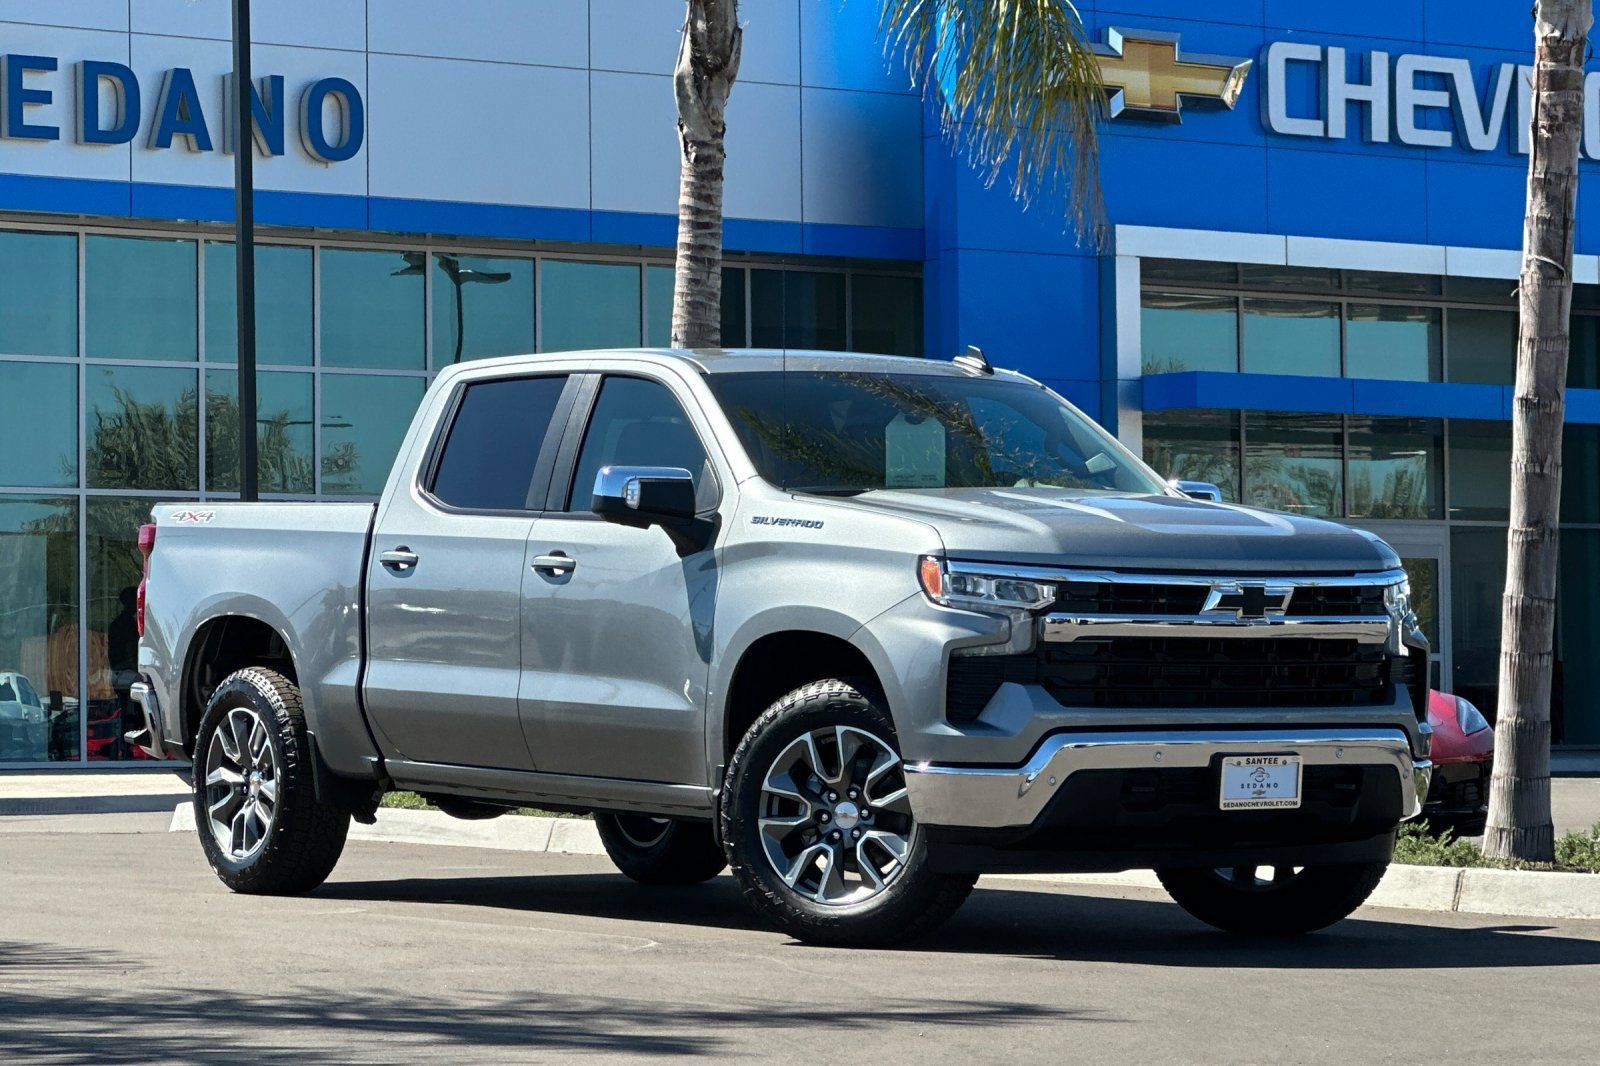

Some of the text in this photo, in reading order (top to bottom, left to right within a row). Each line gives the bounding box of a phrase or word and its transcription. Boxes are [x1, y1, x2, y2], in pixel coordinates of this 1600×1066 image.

[1261, 41, 1600, 160] CHEV
[751, 516, 824, 529] SILVERADO
[1245, 757, 1279, 765] SANTEE
[1223, 800, 1298, 808] SEDANOCHEVROLET.COM
